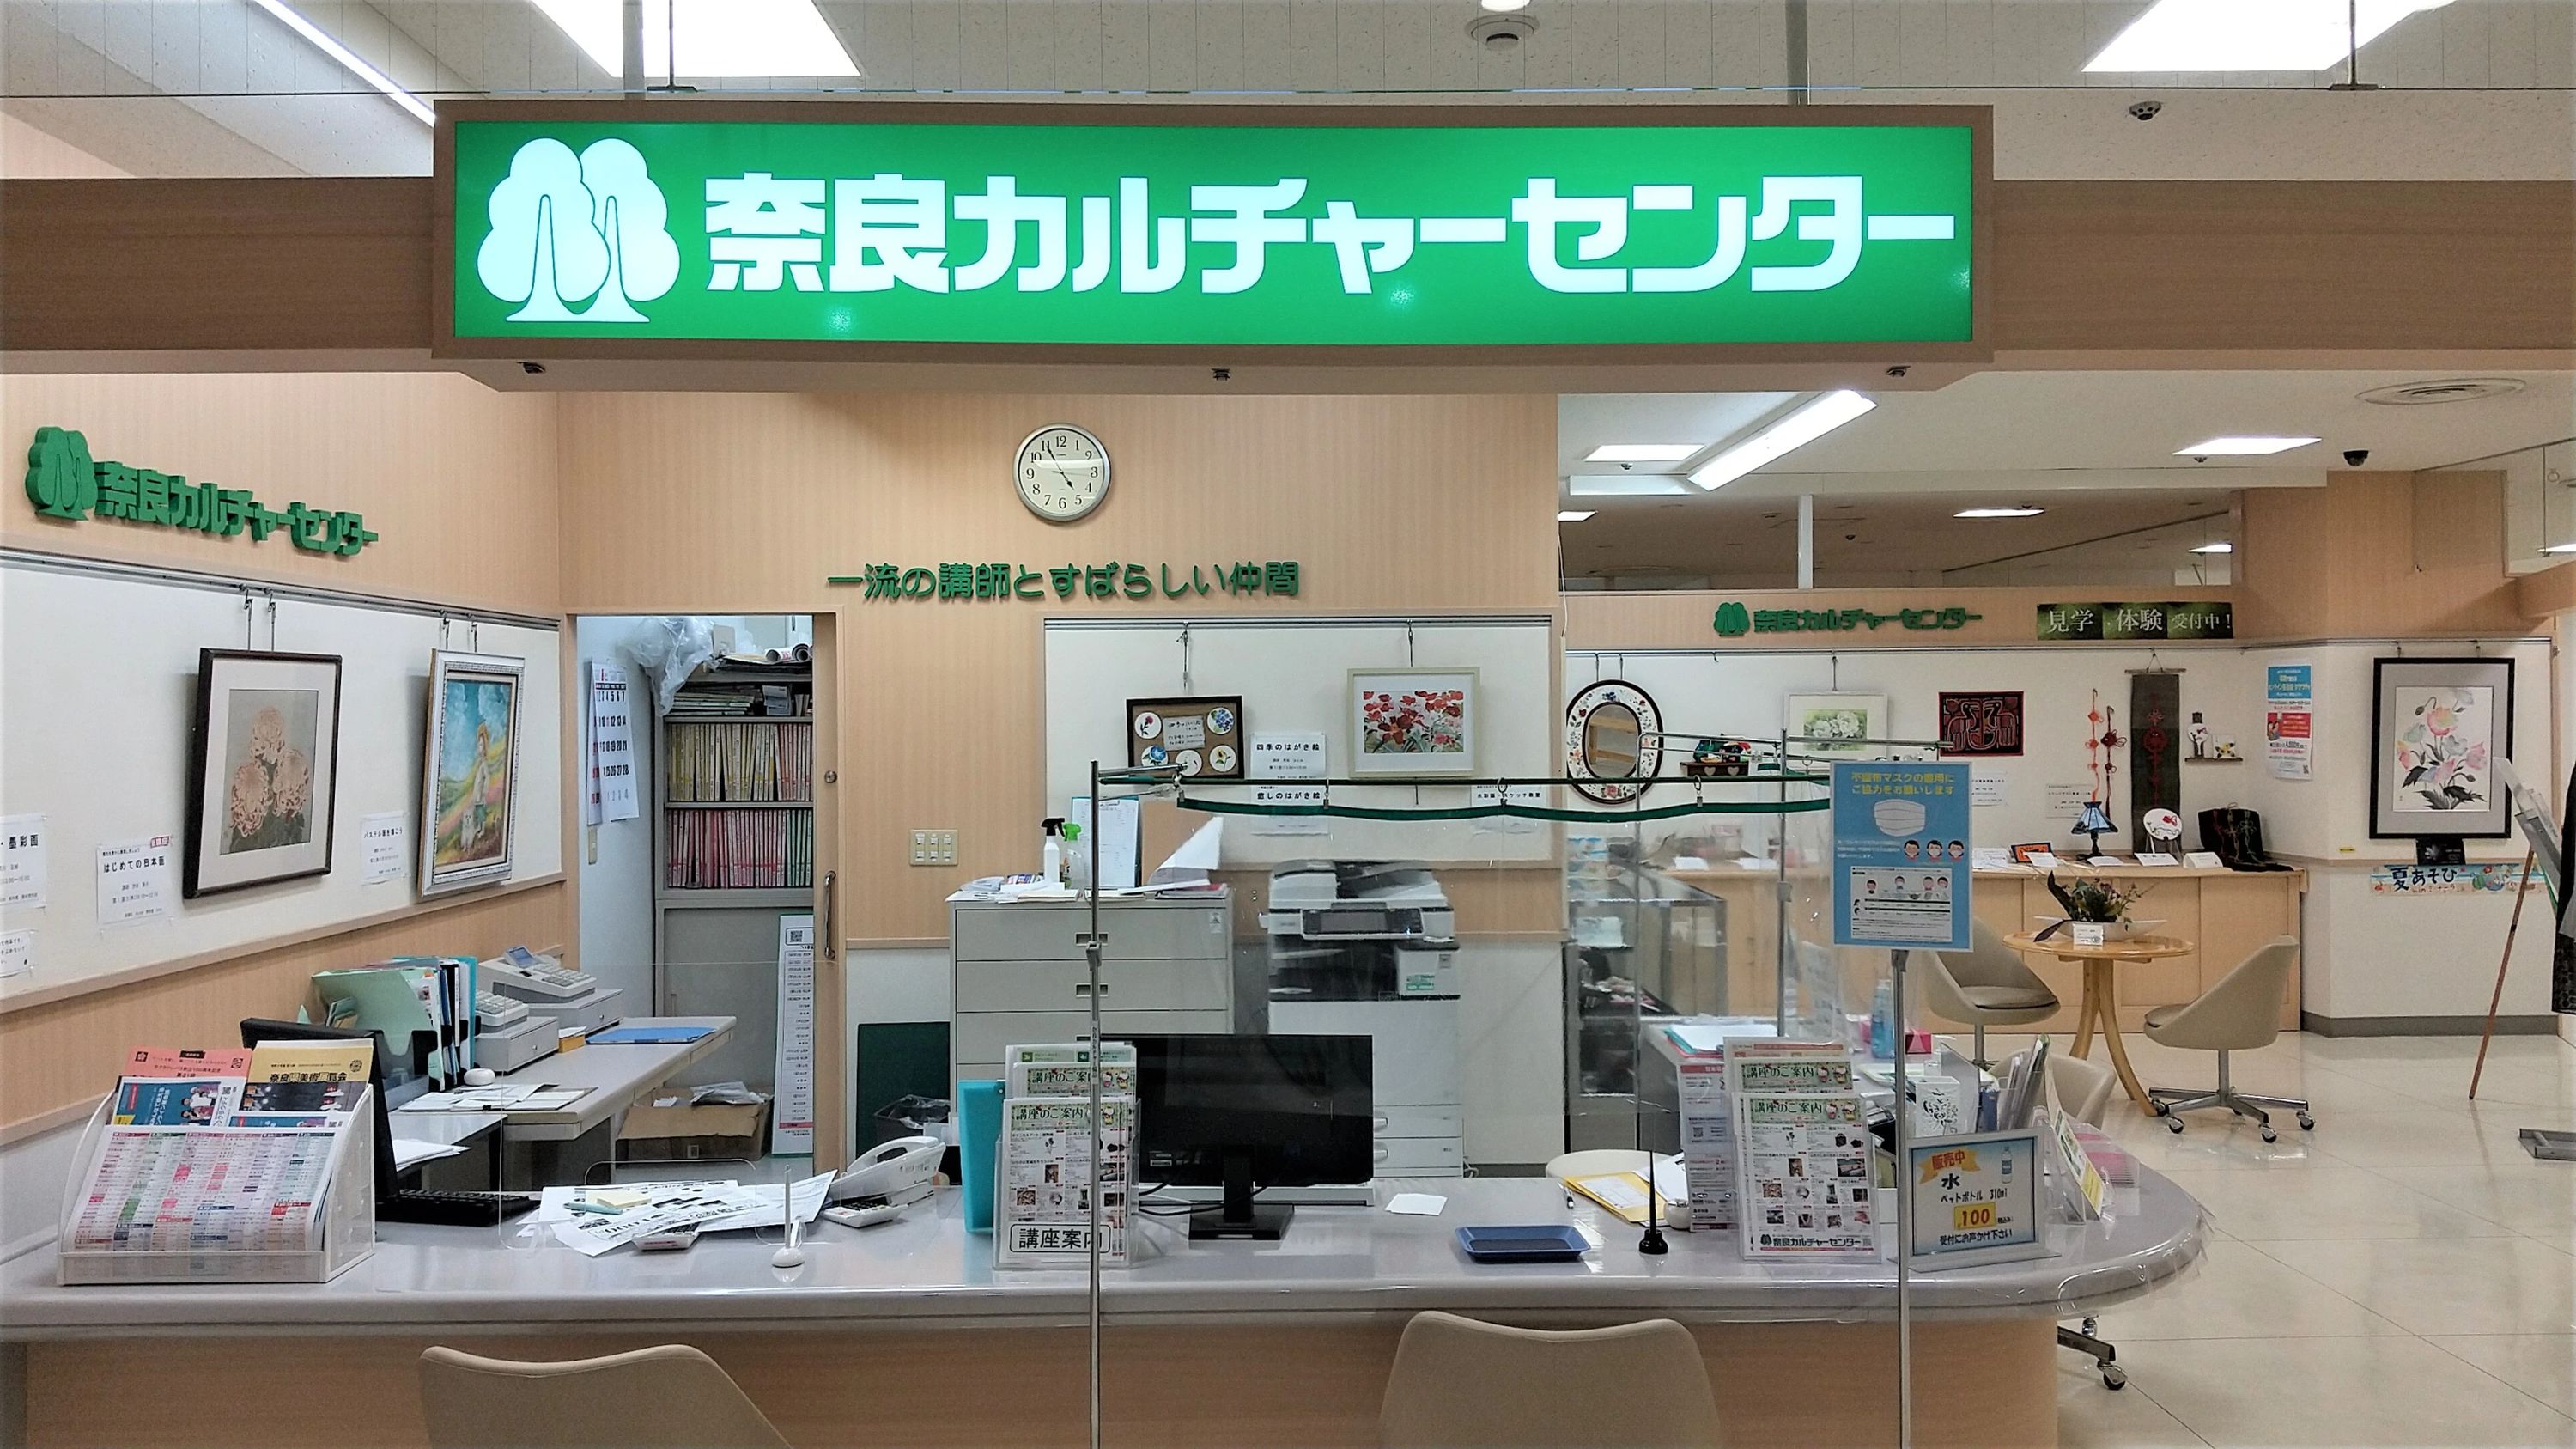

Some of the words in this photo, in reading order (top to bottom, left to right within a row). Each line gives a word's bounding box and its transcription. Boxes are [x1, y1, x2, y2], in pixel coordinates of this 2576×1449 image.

[703, 172, 1957, 295] 奈良カルチャーセンター
[1042, 440, 1050, 451] 11
[1056, 435, 1066, 447] 12
[1075, 439, 1079, 450] 1
[1026, 468, 1034, 479] 9
[1091, 466, 1098, 478] 3
[1033, 484, 1041, 495] 8
[1085, 482, 1092, 493] 4
[1044, 495, 1051, 506] 7
[1059, 497, 1066, 508] 6
[1075, 495, 1082, 505] 5
[94, 460, 379, 557] 奈良カルチャーセンター
[827, 561, 1301, 600] 一流の講師とすばらしい仲間
[1753, 607, 1983, 633] 奈良カルチャーセンター
[611, 691, 615, 701] 5
[611, 715, 616, 727] 12
[617, 740, 622, 752] 20
[1256, 743, 1320, 752] 四季のはがき絵
[611, 765, 617, 776] 26
[617, 765, 622, 776] 27
[623, 764, 629, 776] 28
[1257, 791, 1321, 800] 癒しのはがき絵
[103, 855, 165, 874] はじめての日本画
[2390, 866, 2458, 892] 夏あそび
[1031, 1071, 1092, 1083] 講座のご案
[1747, 1066, 1814, 1079] 講座のご案内
[1016, 1107, 1084, 1120] 講座のご案内
[1754, 1102, 1822, 1114] 講座のご案内
[1932, 1149, 1965, 1171] 販売中
[1941, 1172, 1960, 1190] 水
[1941, 1190, 1983, 1203] ペットボトル
[1773, 1237, 1862, 1247] 奈良カルチャーセンター
[1939, 1228, 2013, 1245] 受付にお声かけ下さい
